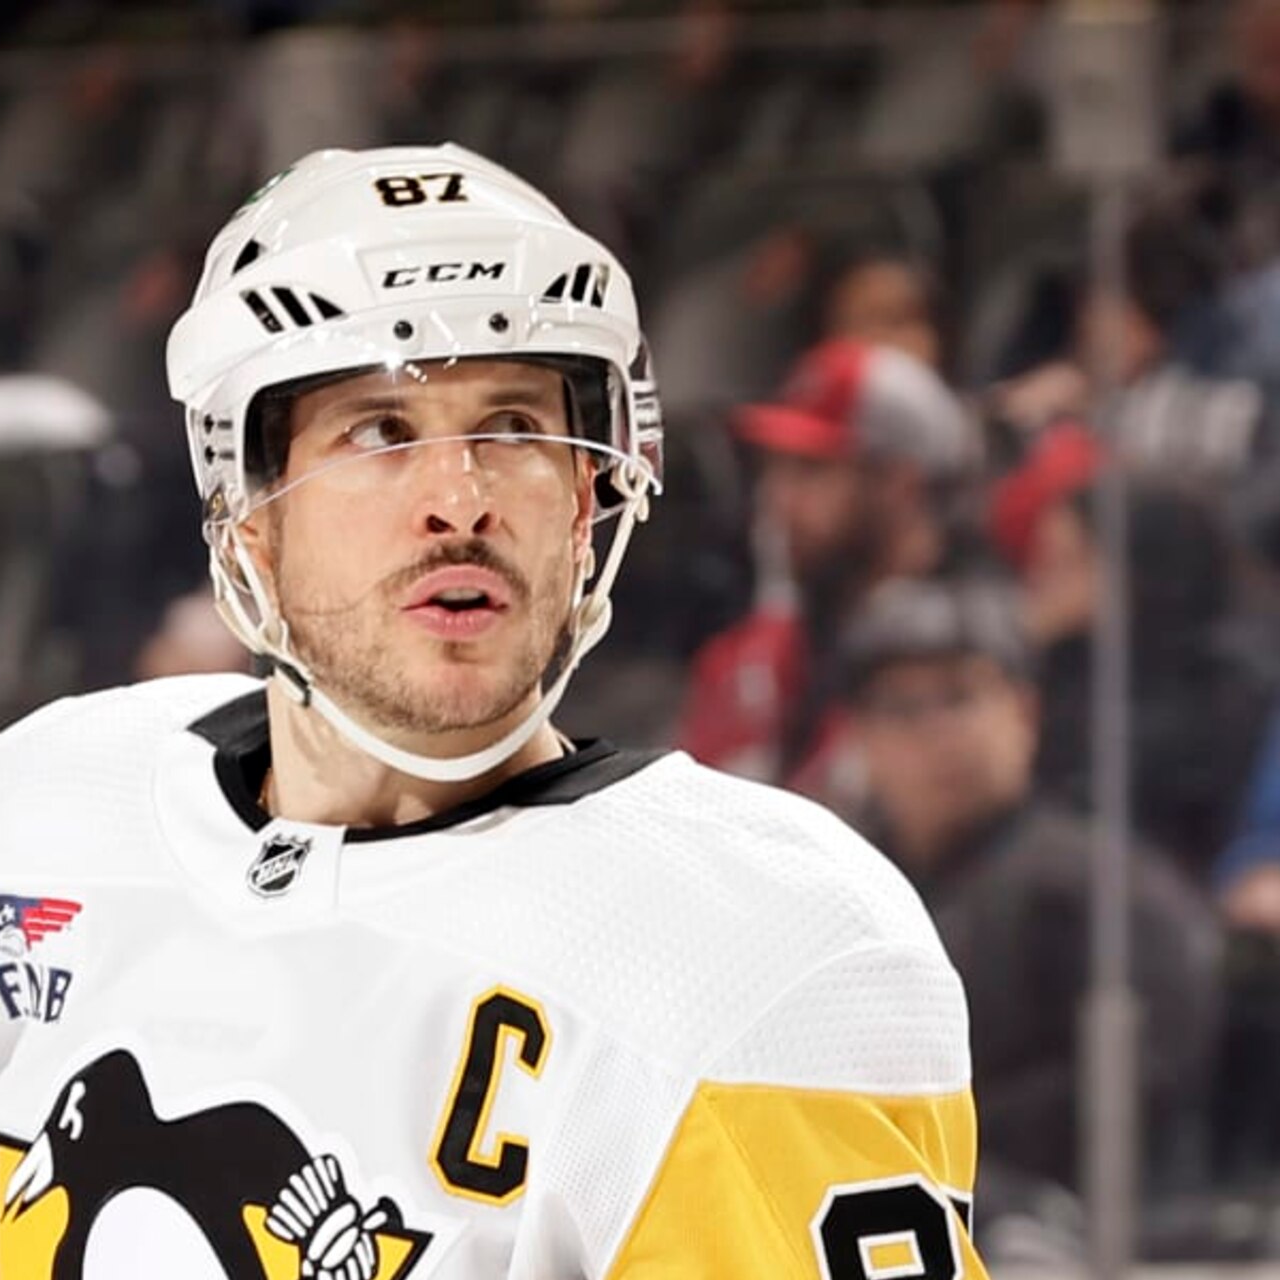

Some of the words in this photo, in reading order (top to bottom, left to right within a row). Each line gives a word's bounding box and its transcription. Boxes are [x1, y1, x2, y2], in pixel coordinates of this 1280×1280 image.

[374, 172, 468, 207] 87
[382, 261, 506, 288] CCM
[427, 984, 554, 1207] C
